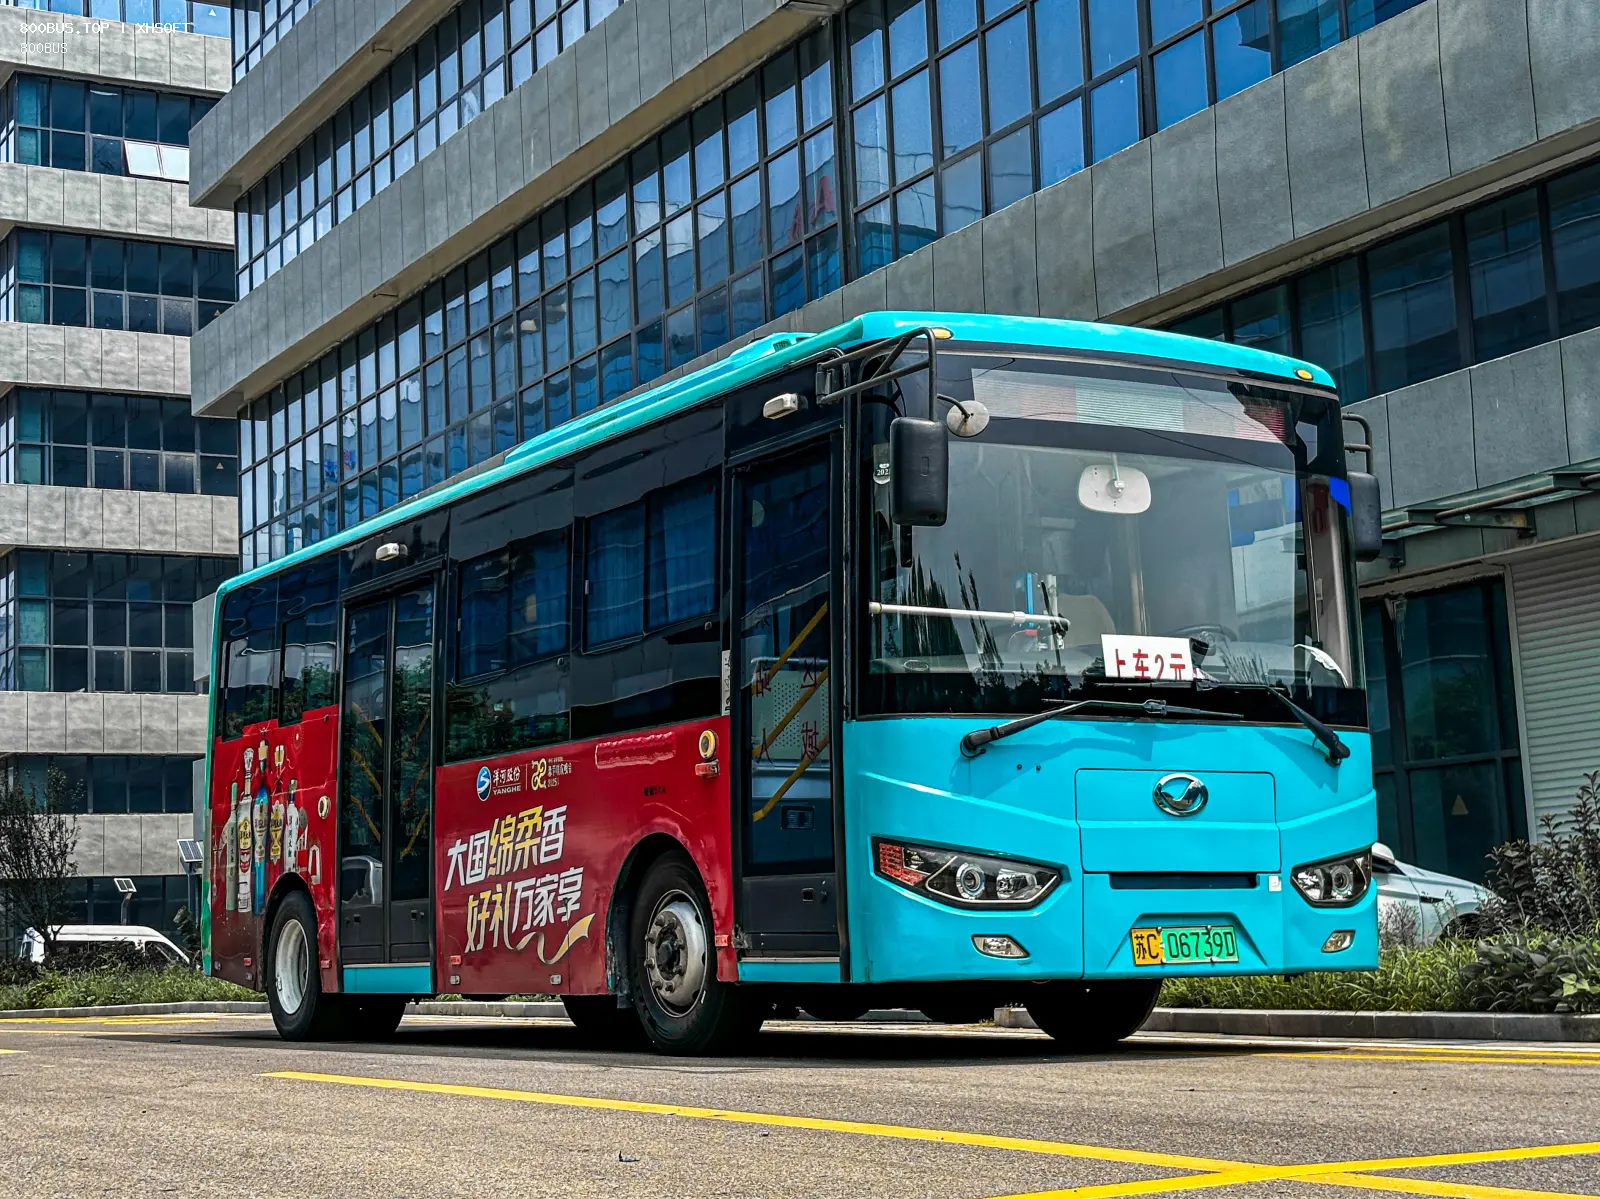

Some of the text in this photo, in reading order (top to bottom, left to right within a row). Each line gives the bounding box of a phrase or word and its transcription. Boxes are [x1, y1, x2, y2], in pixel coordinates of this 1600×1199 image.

[493, 766, 521, 786] 洋河股份
[493, 786, 521, 796] YANGHE
[444, 805, 568, 891] 大国绵柔香
[464, 866, 584, 953] 好礼万家享
